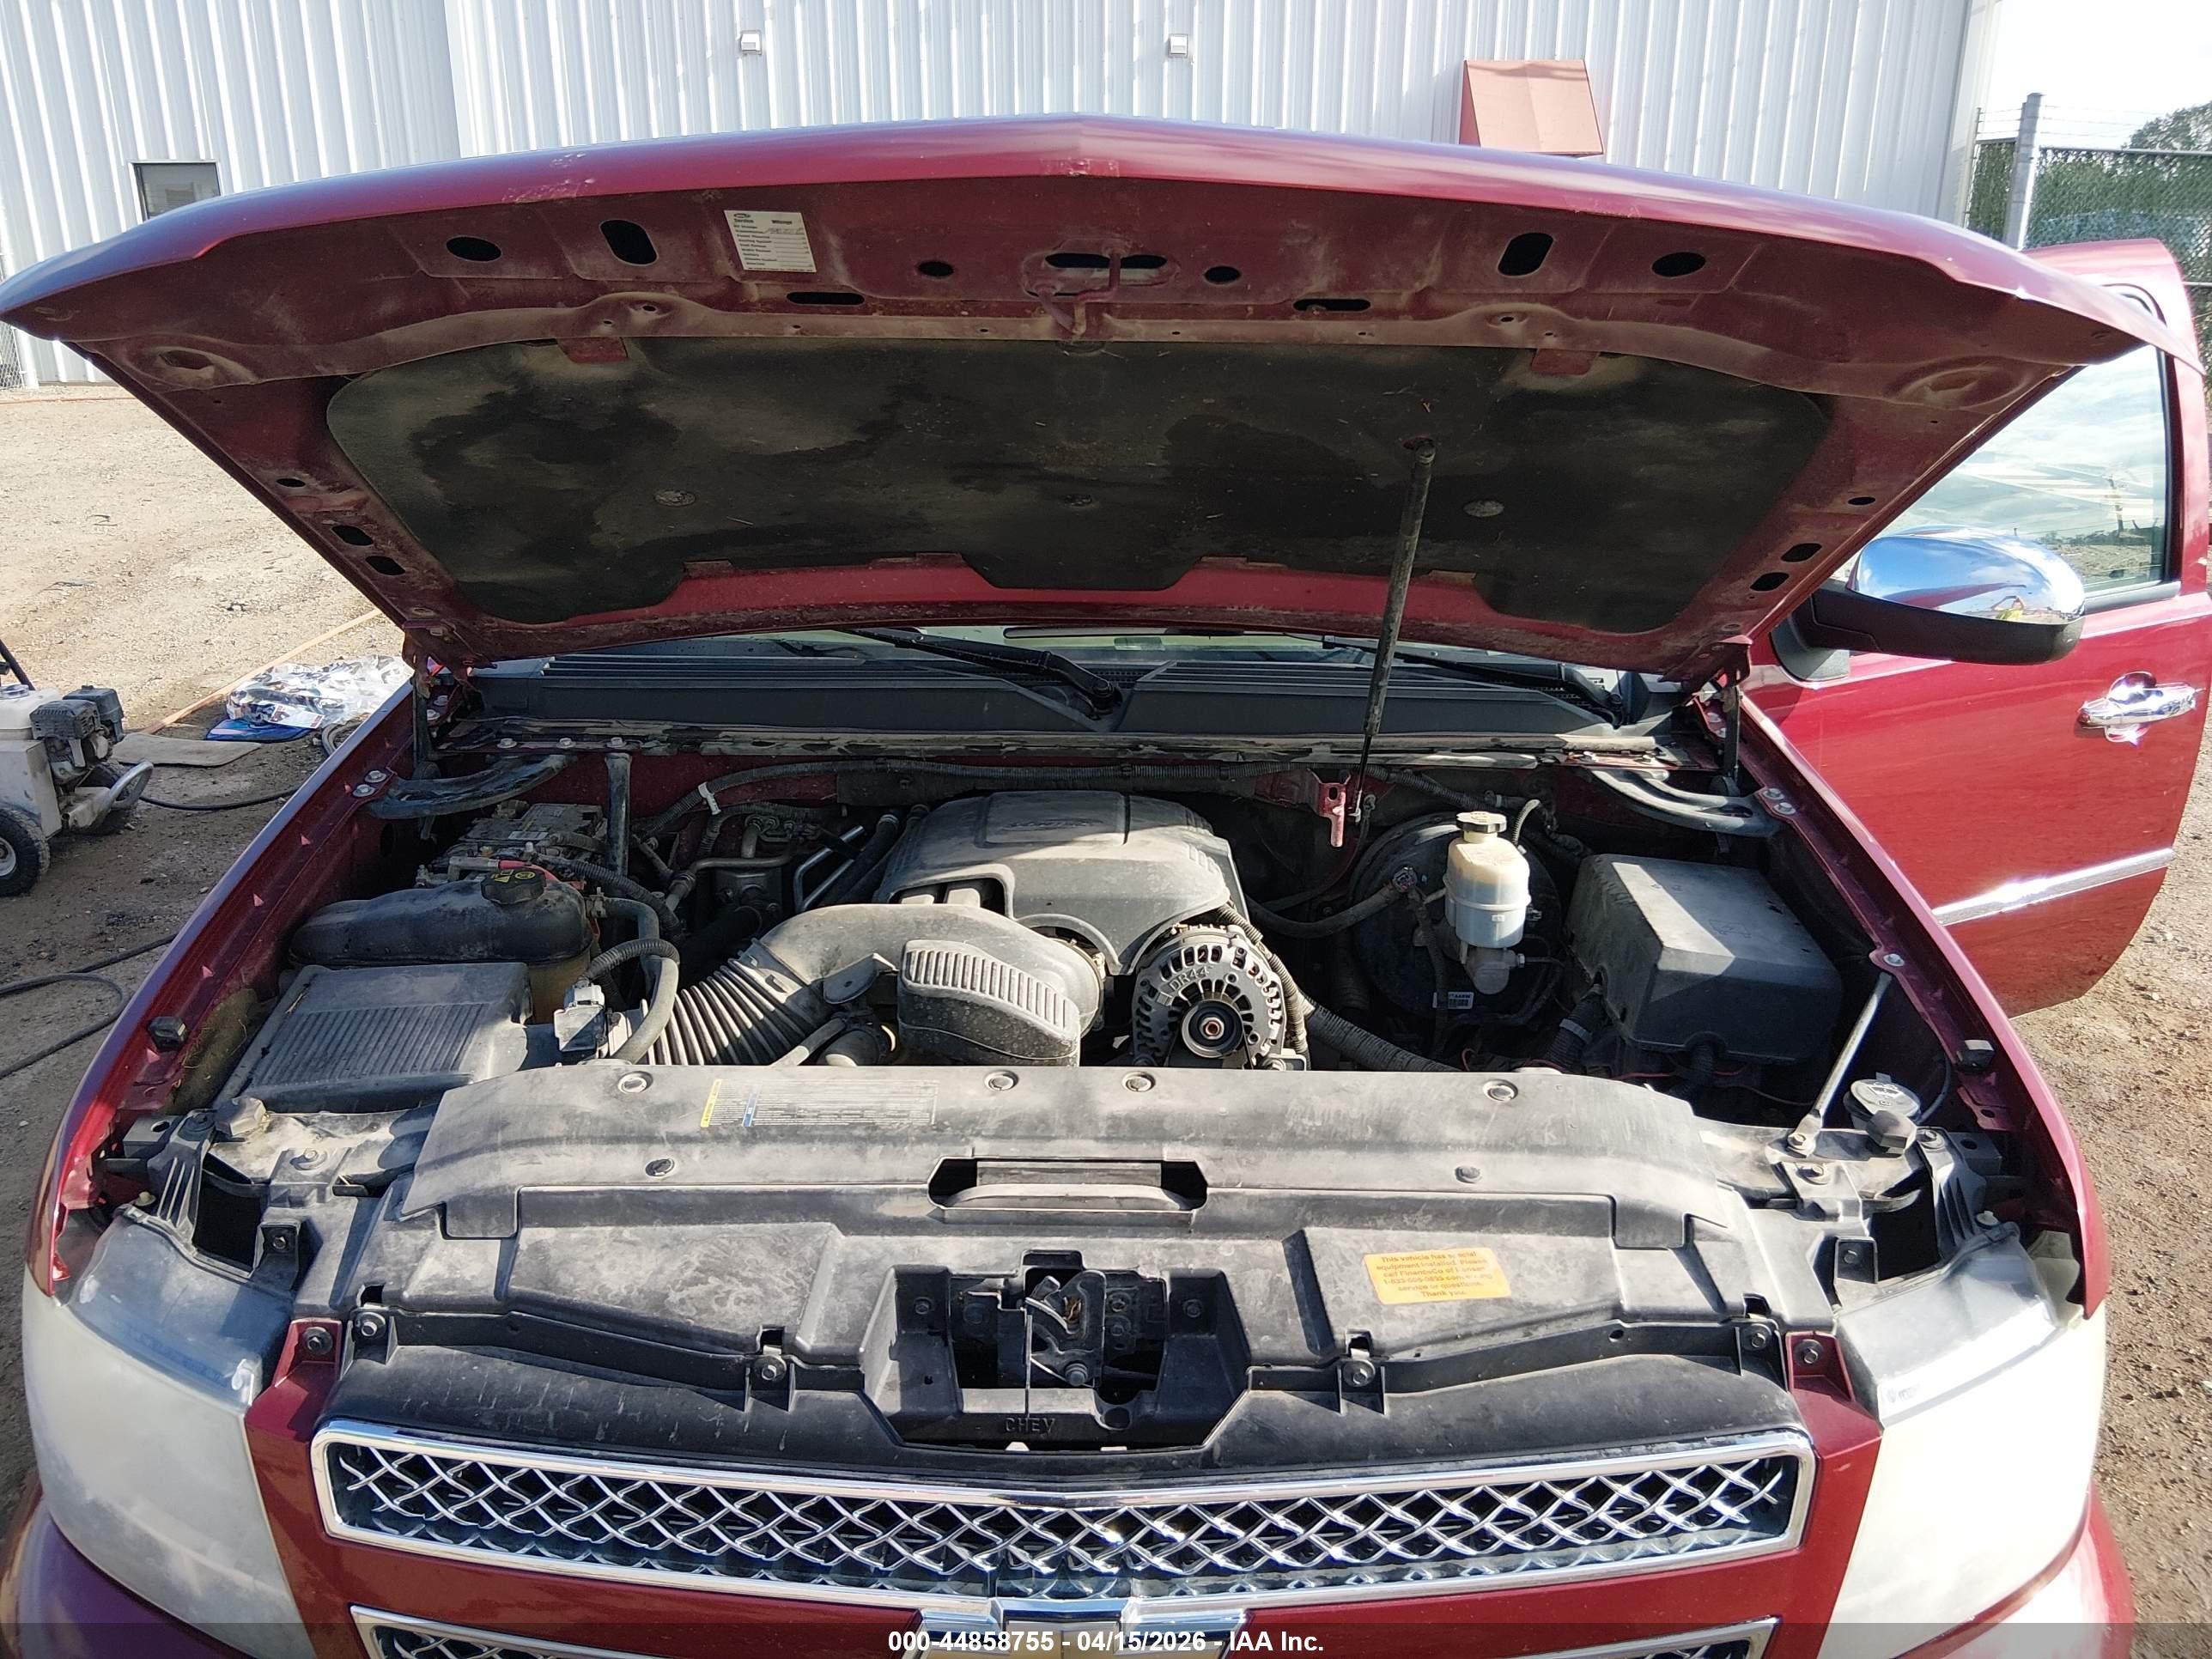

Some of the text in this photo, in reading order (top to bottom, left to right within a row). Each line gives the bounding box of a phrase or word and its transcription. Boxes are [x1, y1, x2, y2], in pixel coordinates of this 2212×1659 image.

[1169, 965, 1210, 991] DR44
[1376, 1263, 1420, 1272] equipment
[1005, 1417, 1056, 1434] CHEV
